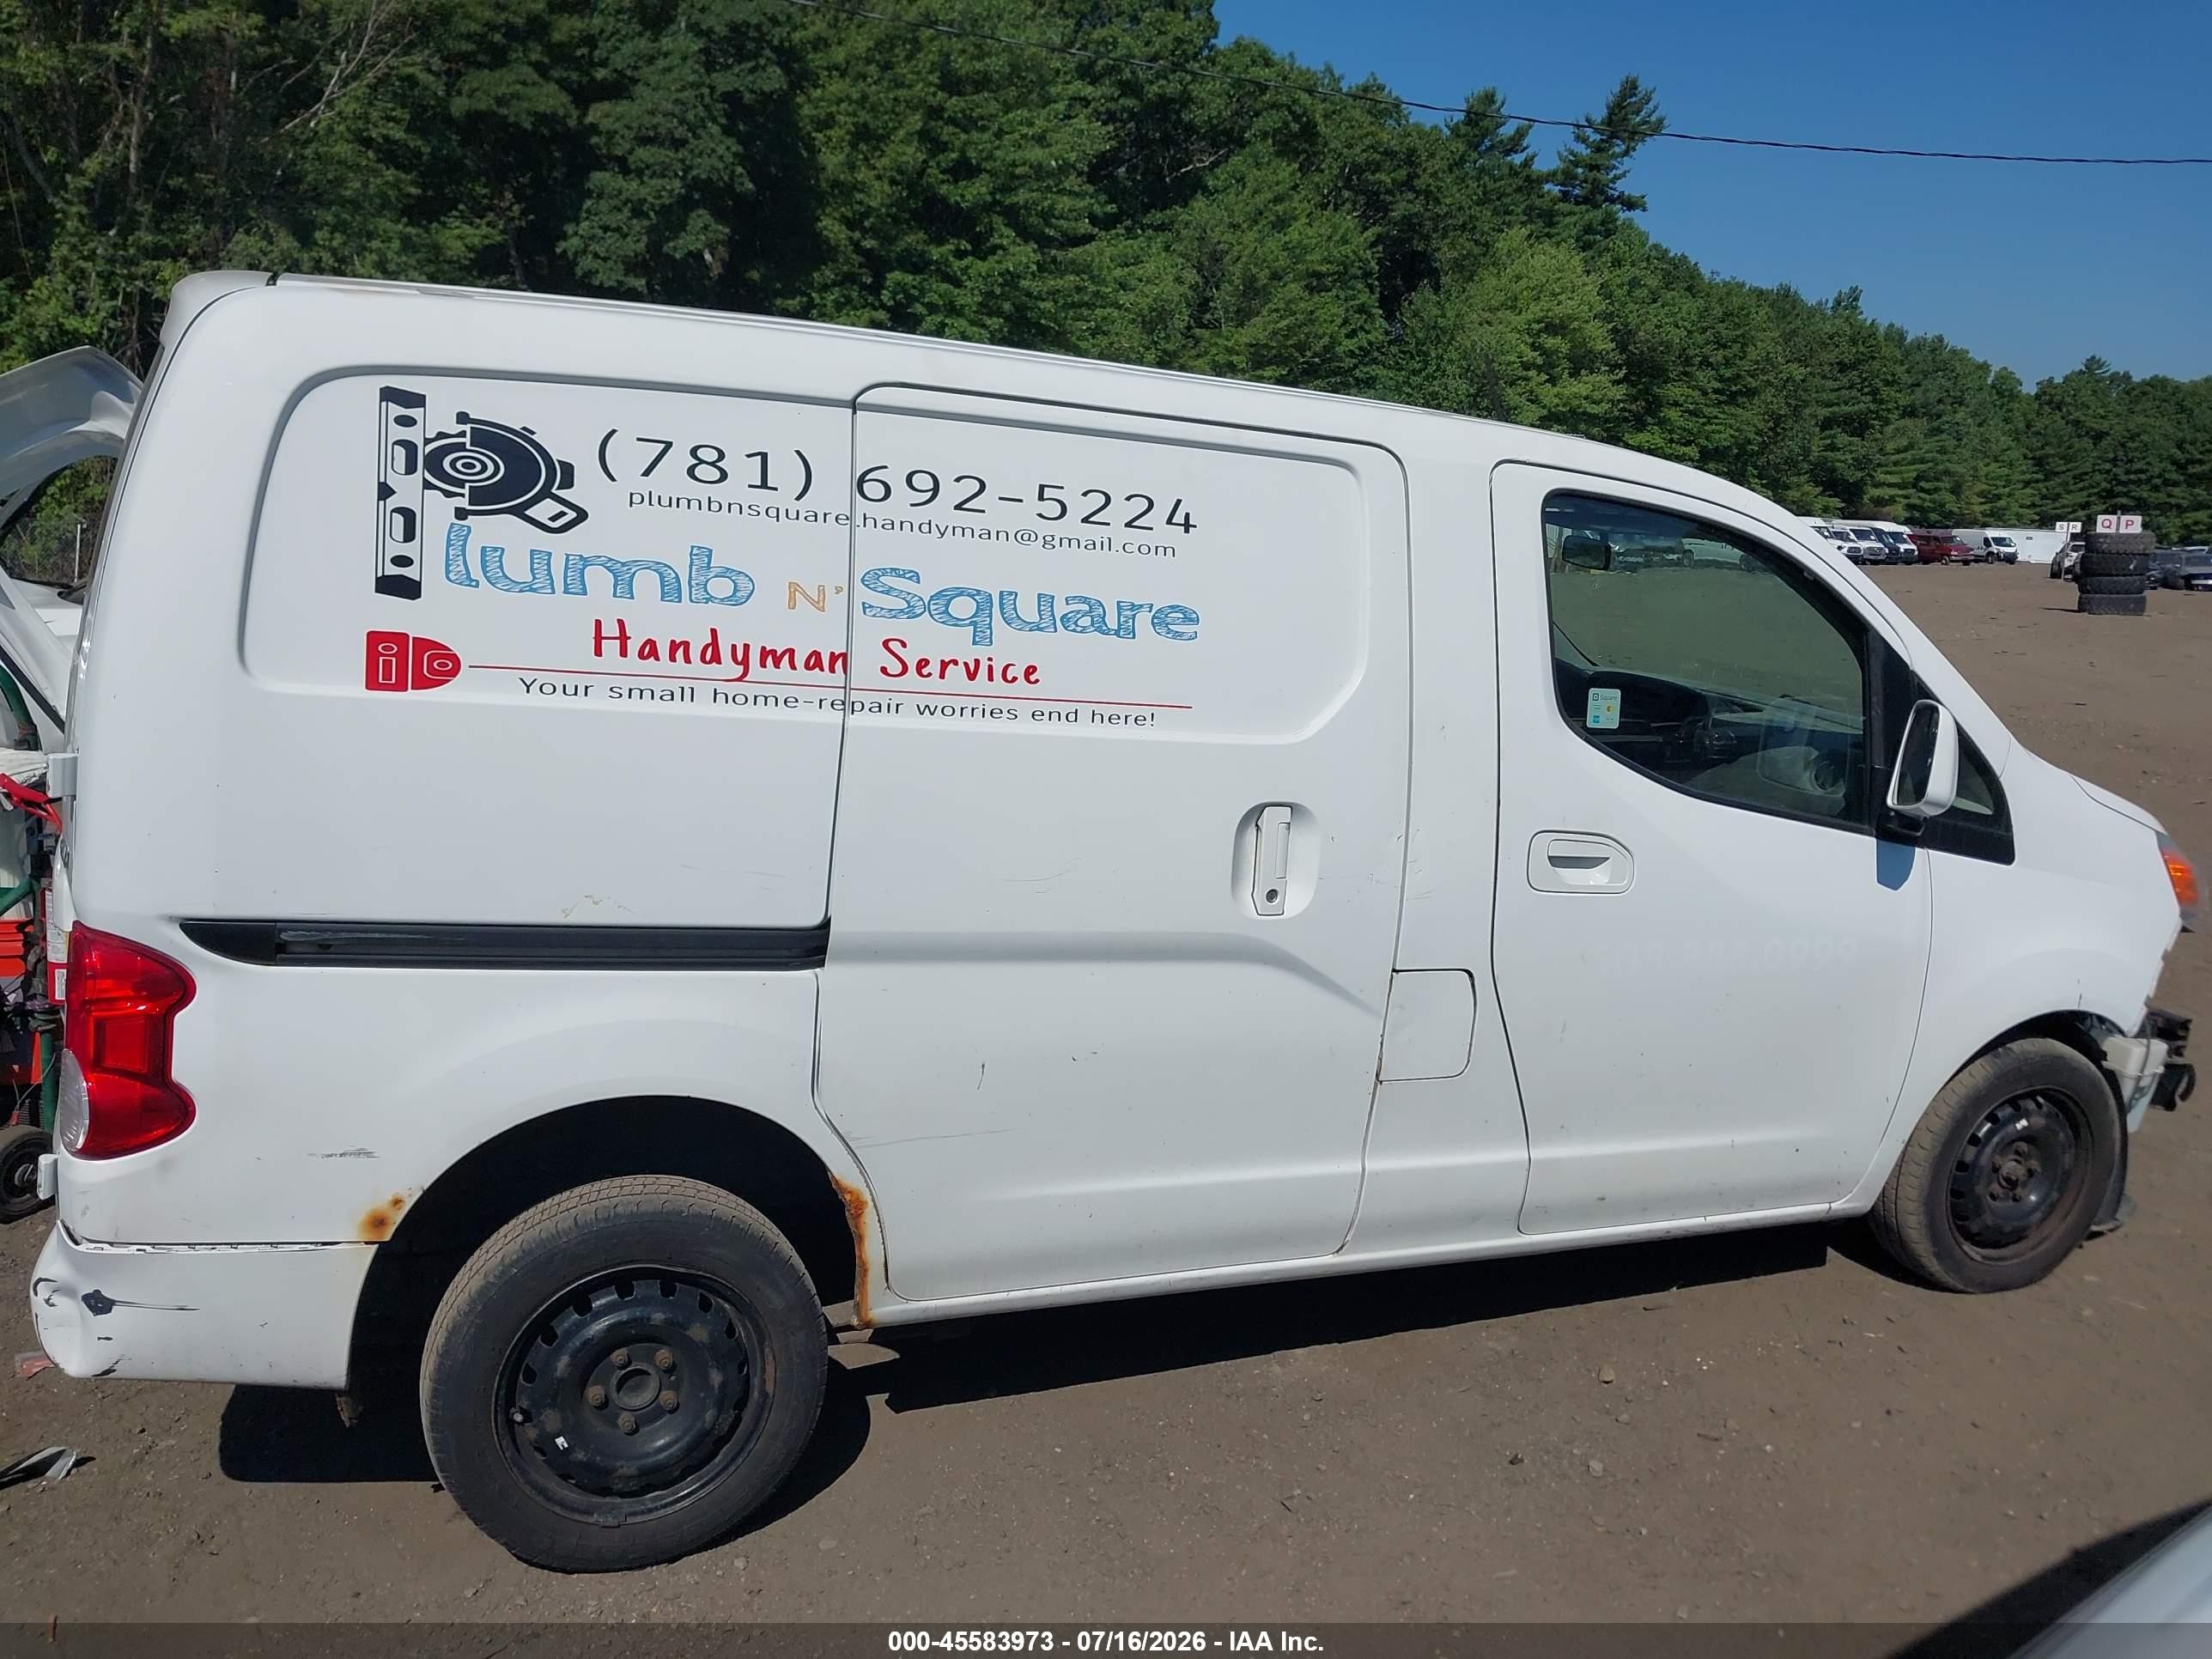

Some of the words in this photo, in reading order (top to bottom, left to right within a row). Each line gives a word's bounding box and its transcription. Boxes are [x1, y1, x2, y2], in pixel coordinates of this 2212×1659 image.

[599, 428, 813, 501] (781)
[856, 465, 1198, 534] 692-5224
[629, 489, 1176, 558] plumbnsquare.handyman@gmail.com
[2101, 518, 2112, 530] Q
[2124, 519, 2135, 530] P
[860, 566, 1200, 646] Square
[592, 617, 848, 683] Handyman
[878, 638, 1042, 686] Service
[520, 677, 594, 698] Your
[608, 684, 696, 703] small
[713, 687, 904, 718] home-repair
[916, 699, 1019, 721] worries
[1030, 707, 1079, 724] end
[1091, 708, 1155, 727] here!
